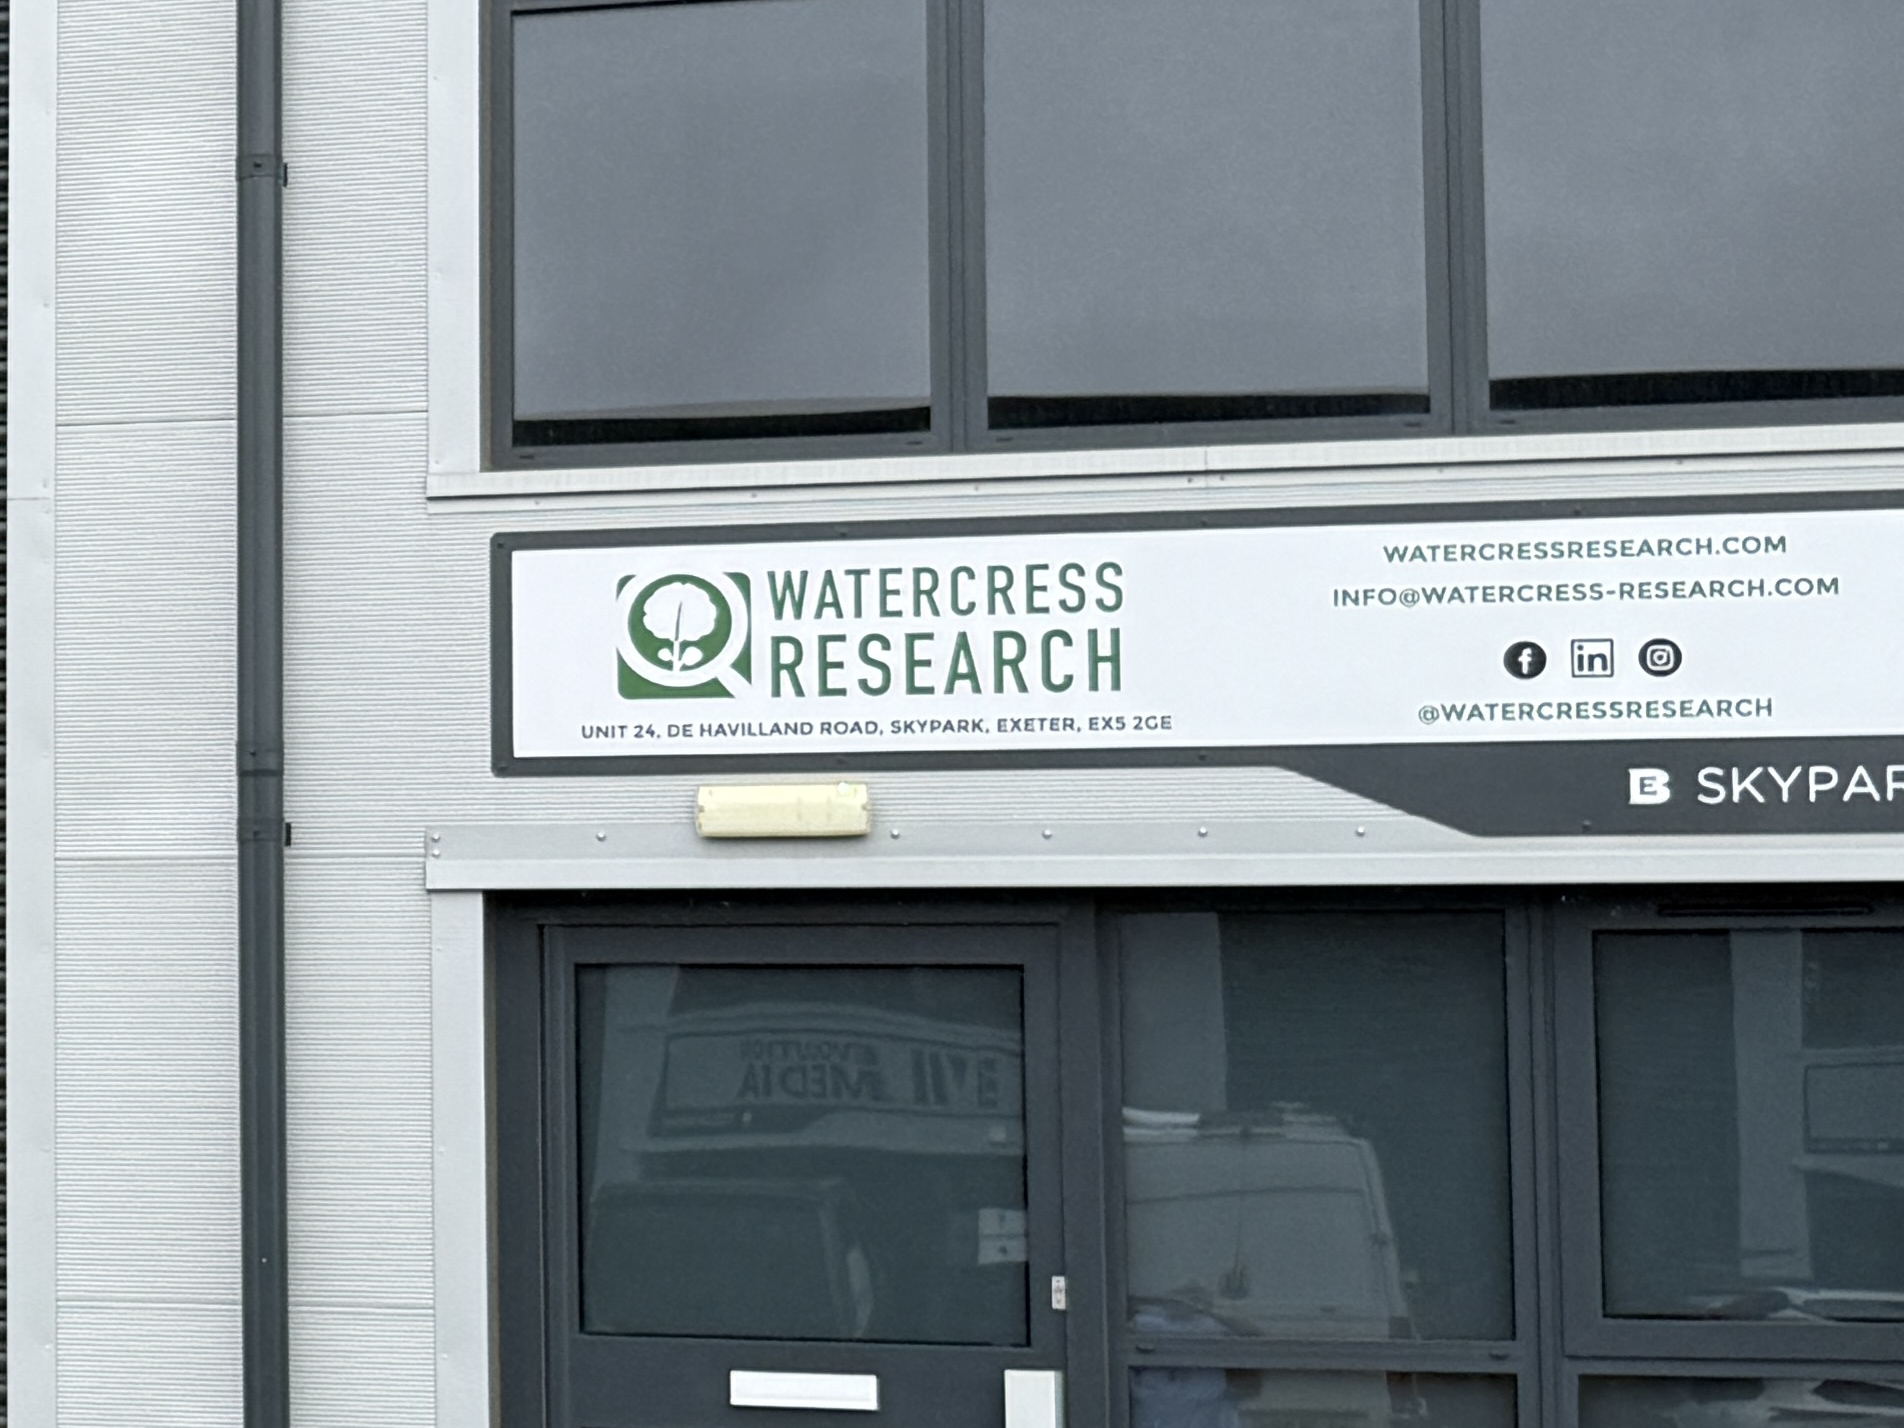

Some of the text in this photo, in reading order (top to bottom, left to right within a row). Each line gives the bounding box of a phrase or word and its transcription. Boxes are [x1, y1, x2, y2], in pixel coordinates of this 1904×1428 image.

[1383, 534, 1788, 565] WATERCRESSRESEARCH.COM
[767, 560, 1125, 622] WATERCRESS
[1333, 576, 1841, 609] INFO@WATERCRESS-RESEARCH.COM
[771, 628, 1122, 698] RESEARCH
[1417, 696, 1774, 726] @WATERCRESSRESEARCH
[581, 724, 628, 739] UNIT
[667, 723, 693, 738] DE
[700, 721, 813, 737] HAVILLAND
[820, 720, 884, 738] ROAD,
[997, 717, 1081, 733] EXETER,
[1088, 716, 1126, 731] EX5
